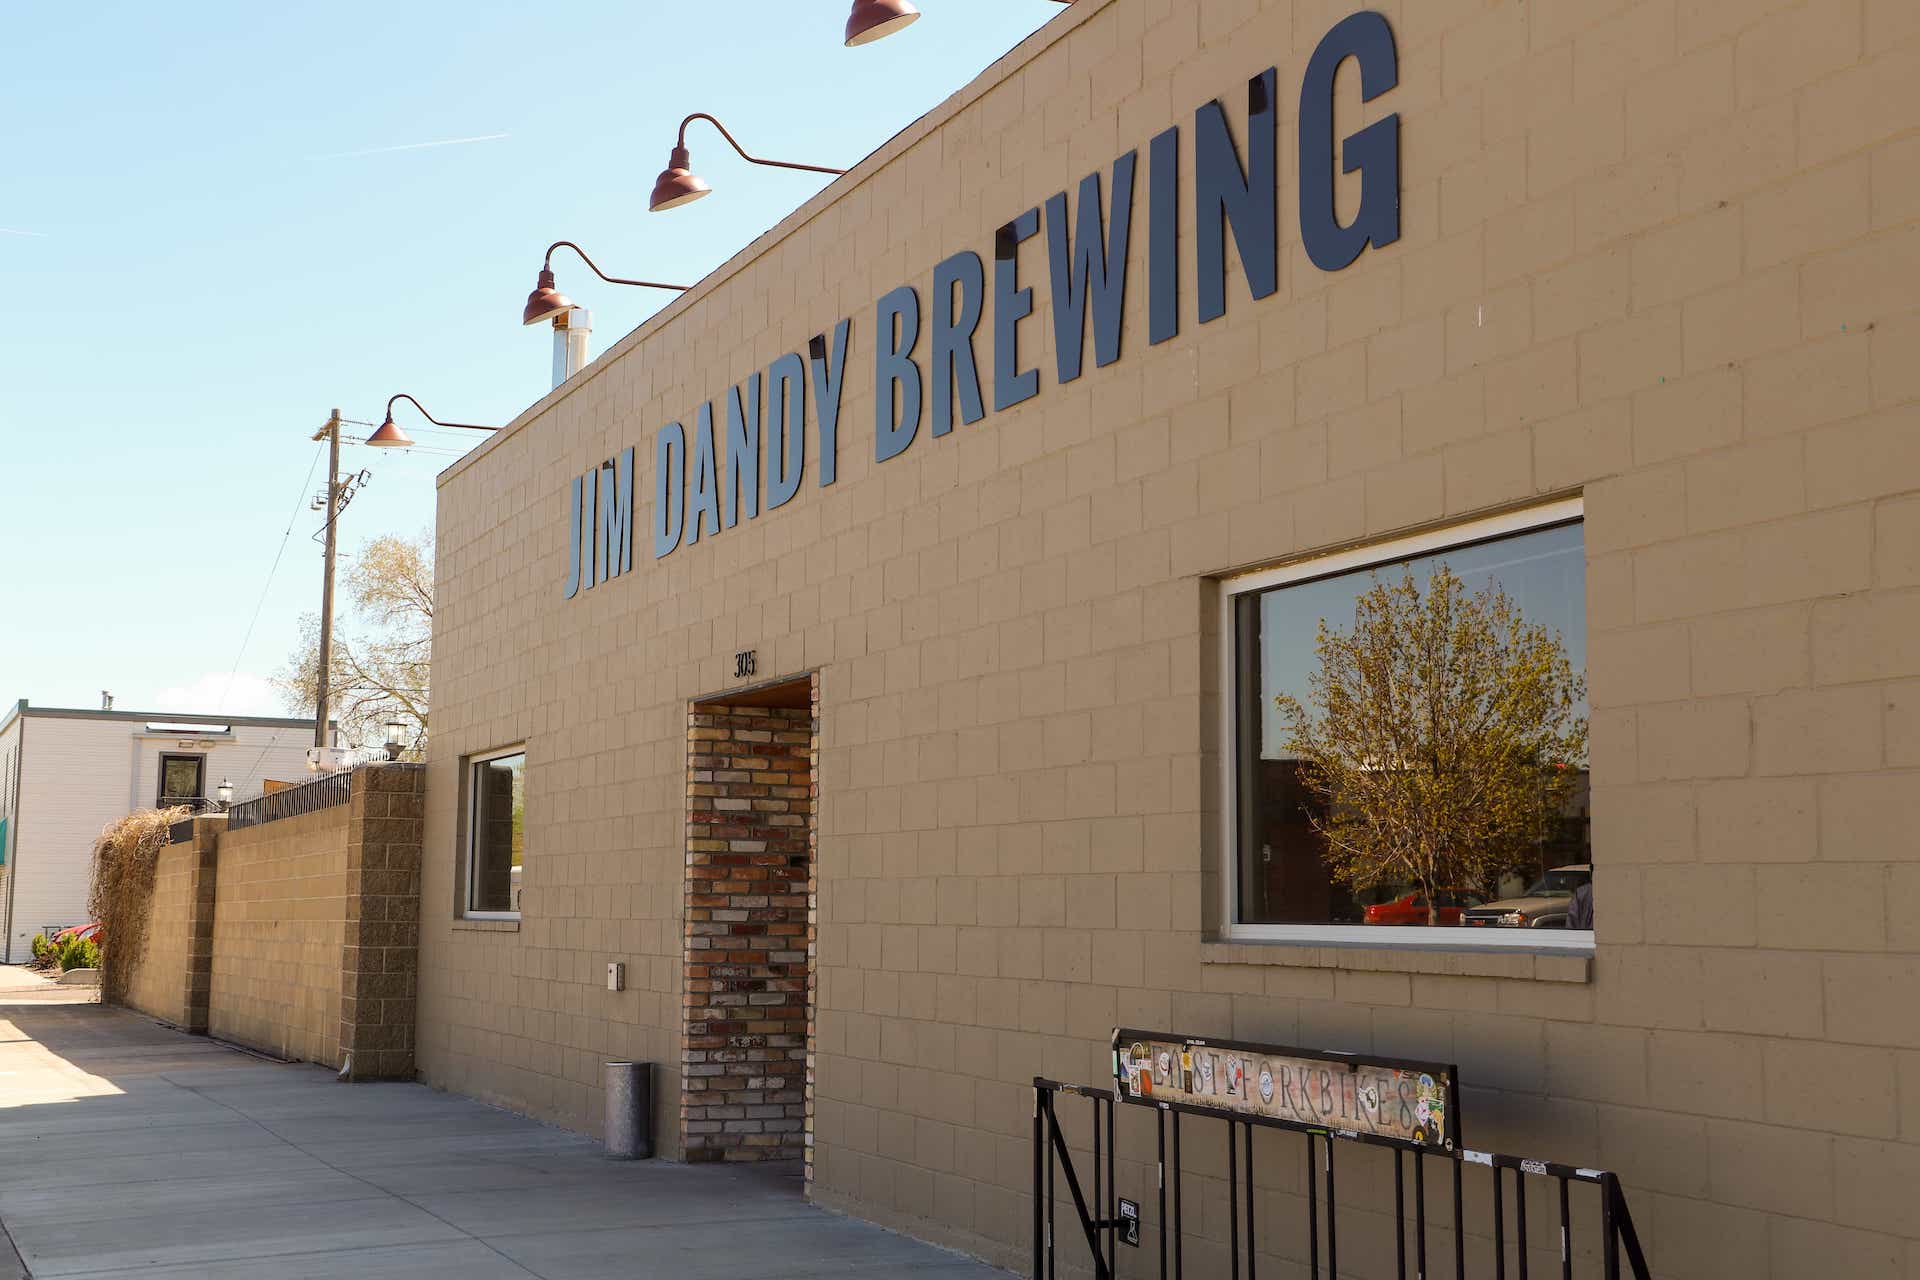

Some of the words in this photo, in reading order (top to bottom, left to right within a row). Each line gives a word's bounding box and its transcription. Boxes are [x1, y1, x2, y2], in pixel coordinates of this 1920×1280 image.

[564, 446, 635, 600] JIM
[655, 317, 850, 560] DANDY
[876, 10, 1400, 464] BREWING
[734, 649, 757, 678] 305
